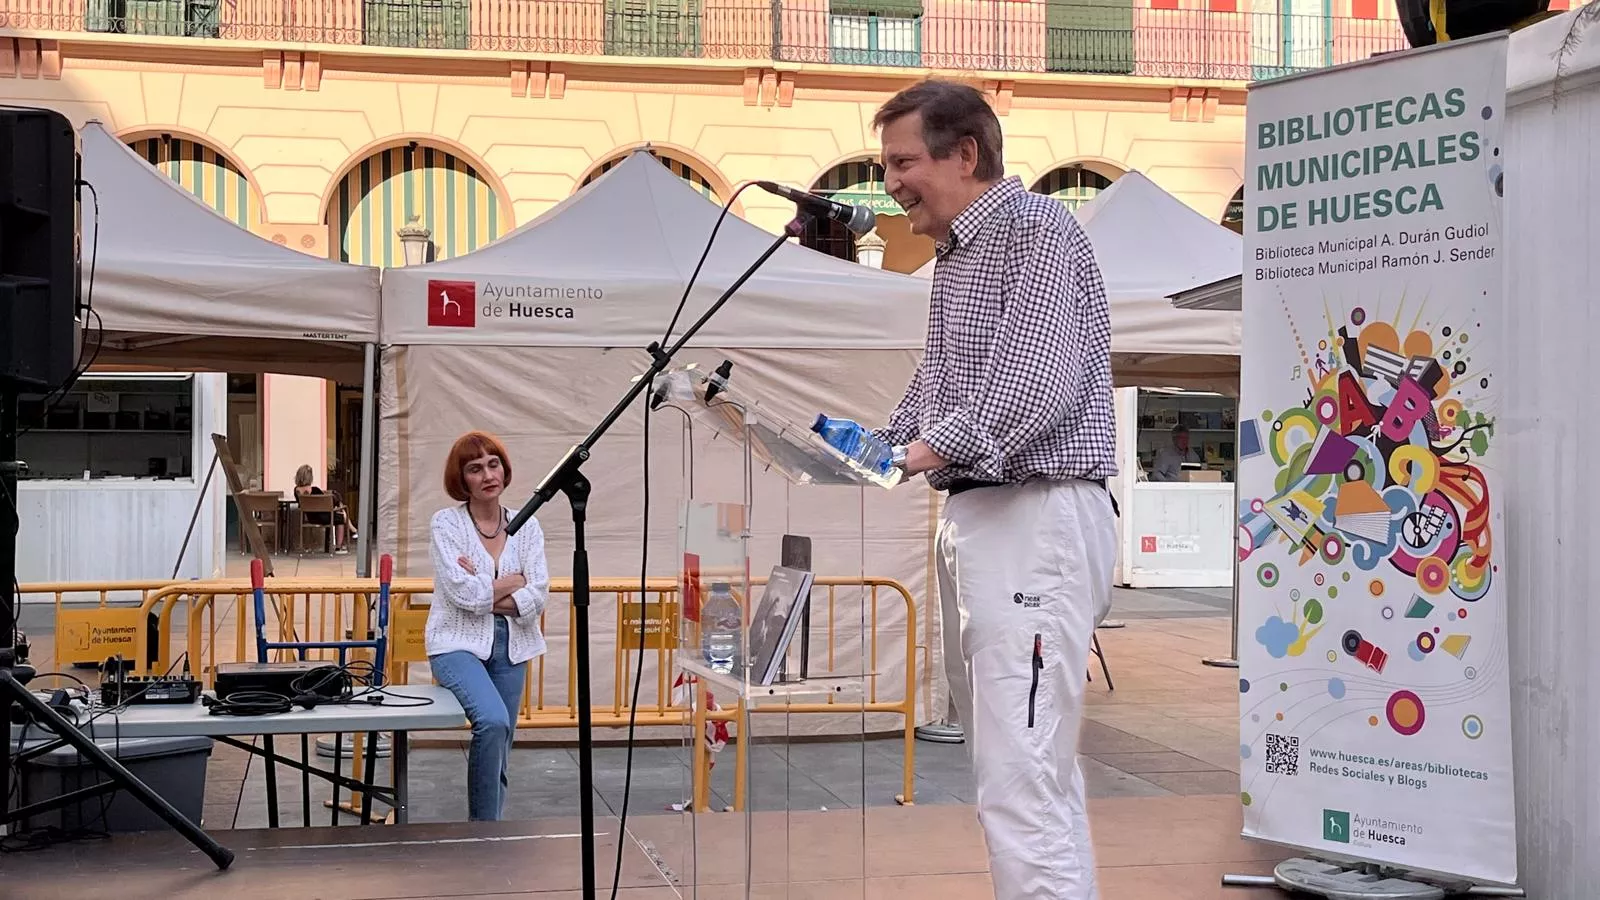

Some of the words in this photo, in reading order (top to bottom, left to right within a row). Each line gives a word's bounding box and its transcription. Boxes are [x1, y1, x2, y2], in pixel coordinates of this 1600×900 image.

[1258, 88, 1465, 149] BIBLIOTECAS
[1257, 131, 1480, 191] MUNICIPALES
[1257, 202, 1297, 232] DE
[1308, 183, 1444, 226] HUESCA
[1256, 246, 1314, 260] Biblioteca
[1319, 235, 1377, 253] Municipal
[1381, 233, 1394, 246] A.
[1400, 228, 1439, 244] Durán
[1445, 222, 1488, 240] Gudiol
[1256, 266, 1314, 280] Biblioteca
[1319, 256, 1377, 274] Municipal
[1382, 252, 1428, 268] Ramón
[1433, 250, 1445, 263] J.
[1450, 246, 1495, 262] Sender
[483, 281, 603, 301] Ayuntamiento
[482, 302, 502, 317] de
[509, 303, 574, 318] Huesca
[92, 626, 136, 634] Ayuntamien
[1310, 748, 1488, 781] www.huesca.es/areas/bibliotecas
[1310, 762, 1339, 776] Redes
[1342, 766, 1385, 782] Sociales
[1388, 776, 1394, 785] y
[1398, 775, 1427, 789] Blogs
[1353, 813, 1423, 834] Ayuntamiento
[1353, 827, 1365, 838] de
[1368, 829, 1405, 845] Huesca
